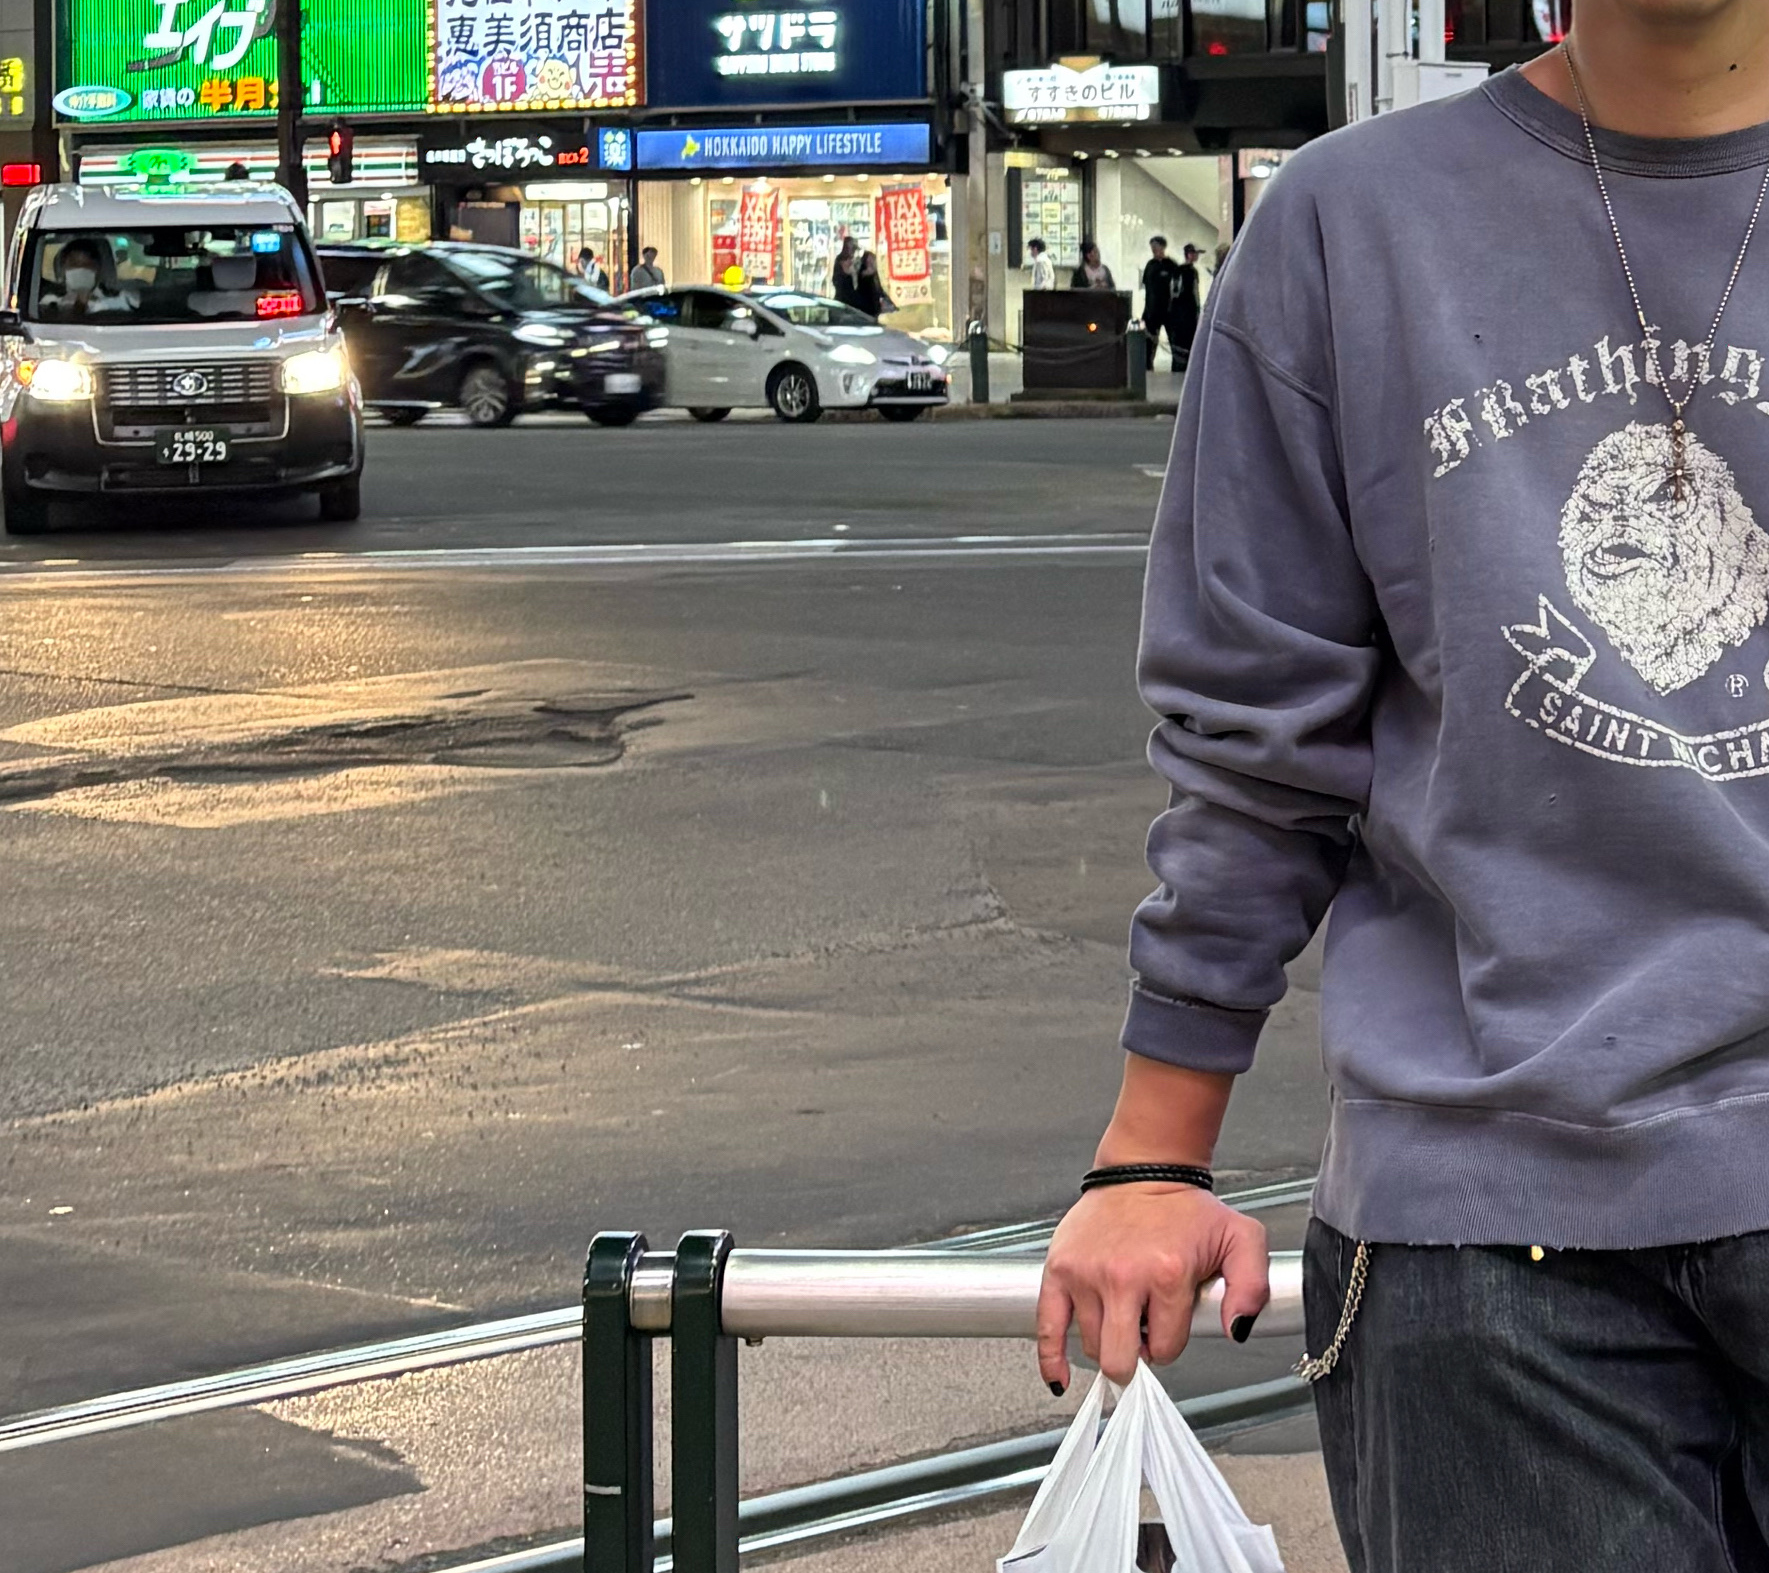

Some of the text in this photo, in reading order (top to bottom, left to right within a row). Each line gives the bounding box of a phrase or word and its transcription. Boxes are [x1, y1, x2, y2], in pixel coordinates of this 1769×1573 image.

[445, 7, 626, 58] 恵美須商店
[716, 10, 838, 52] サツドラ
[492, 77, 517, 101] 1F
[1028, 82, 1135, 103] すすきのビル
[704, 132, 882, 157] HOKKAIDO HAPPY LIFESTYLE
[886, 192, 920, 219] TAX
[889, 219, 923, 239] FREE
[1539, 691, 1658, 759] SAINT
